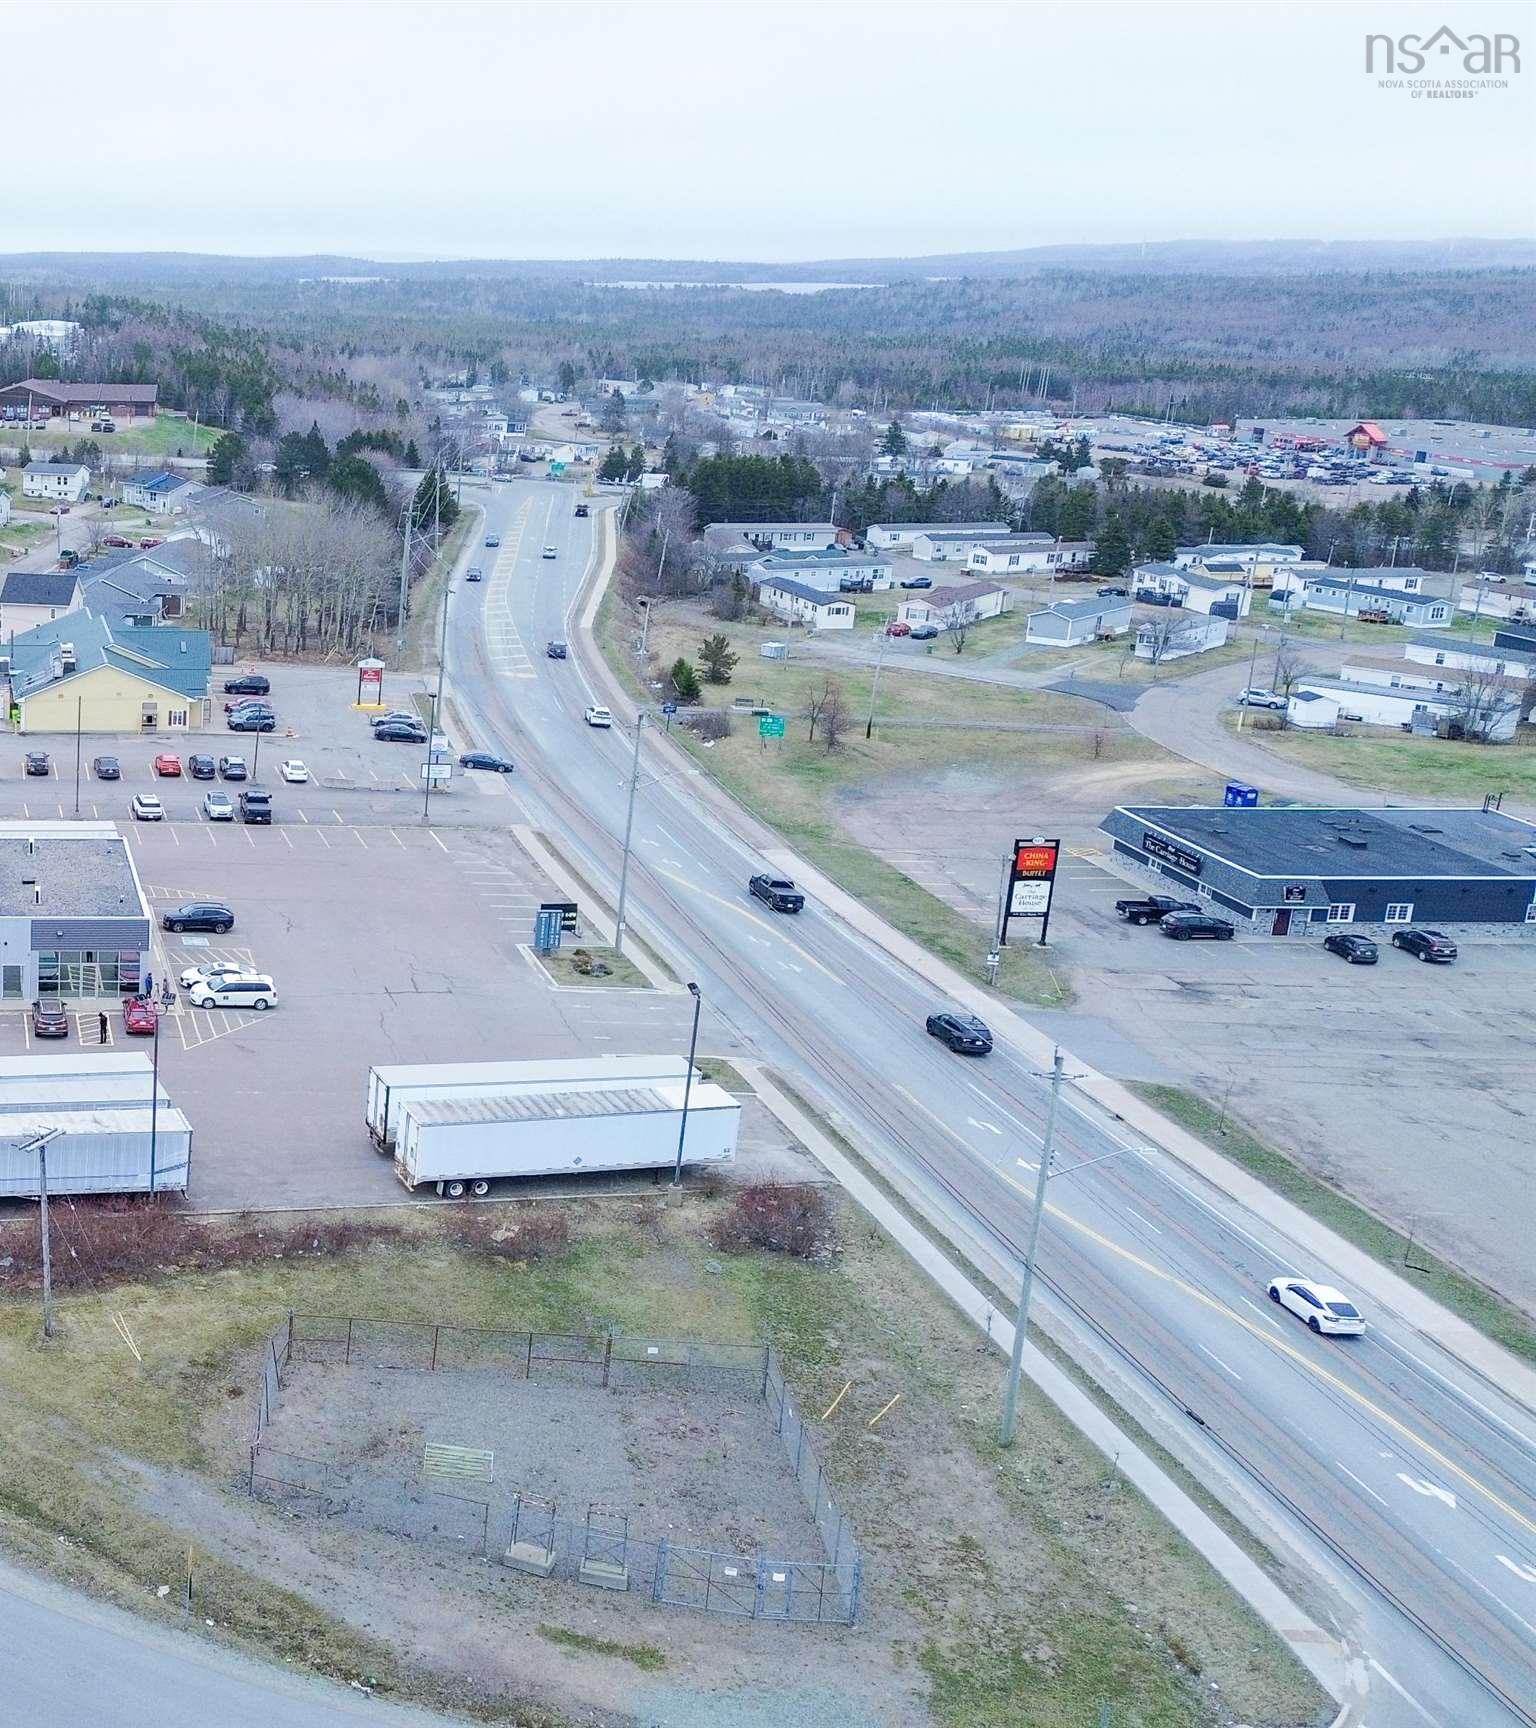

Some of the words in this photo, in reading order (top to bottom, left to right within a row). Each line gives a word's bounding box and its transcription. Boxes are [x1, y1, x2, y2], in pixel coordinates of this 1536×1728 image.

[1023, 852, 1049, 860] CHINA
[1145, 840, 1155, 851] The
[1156, 845, 1178, 863] Carriage
[1179, 857, 1198, 872] House
